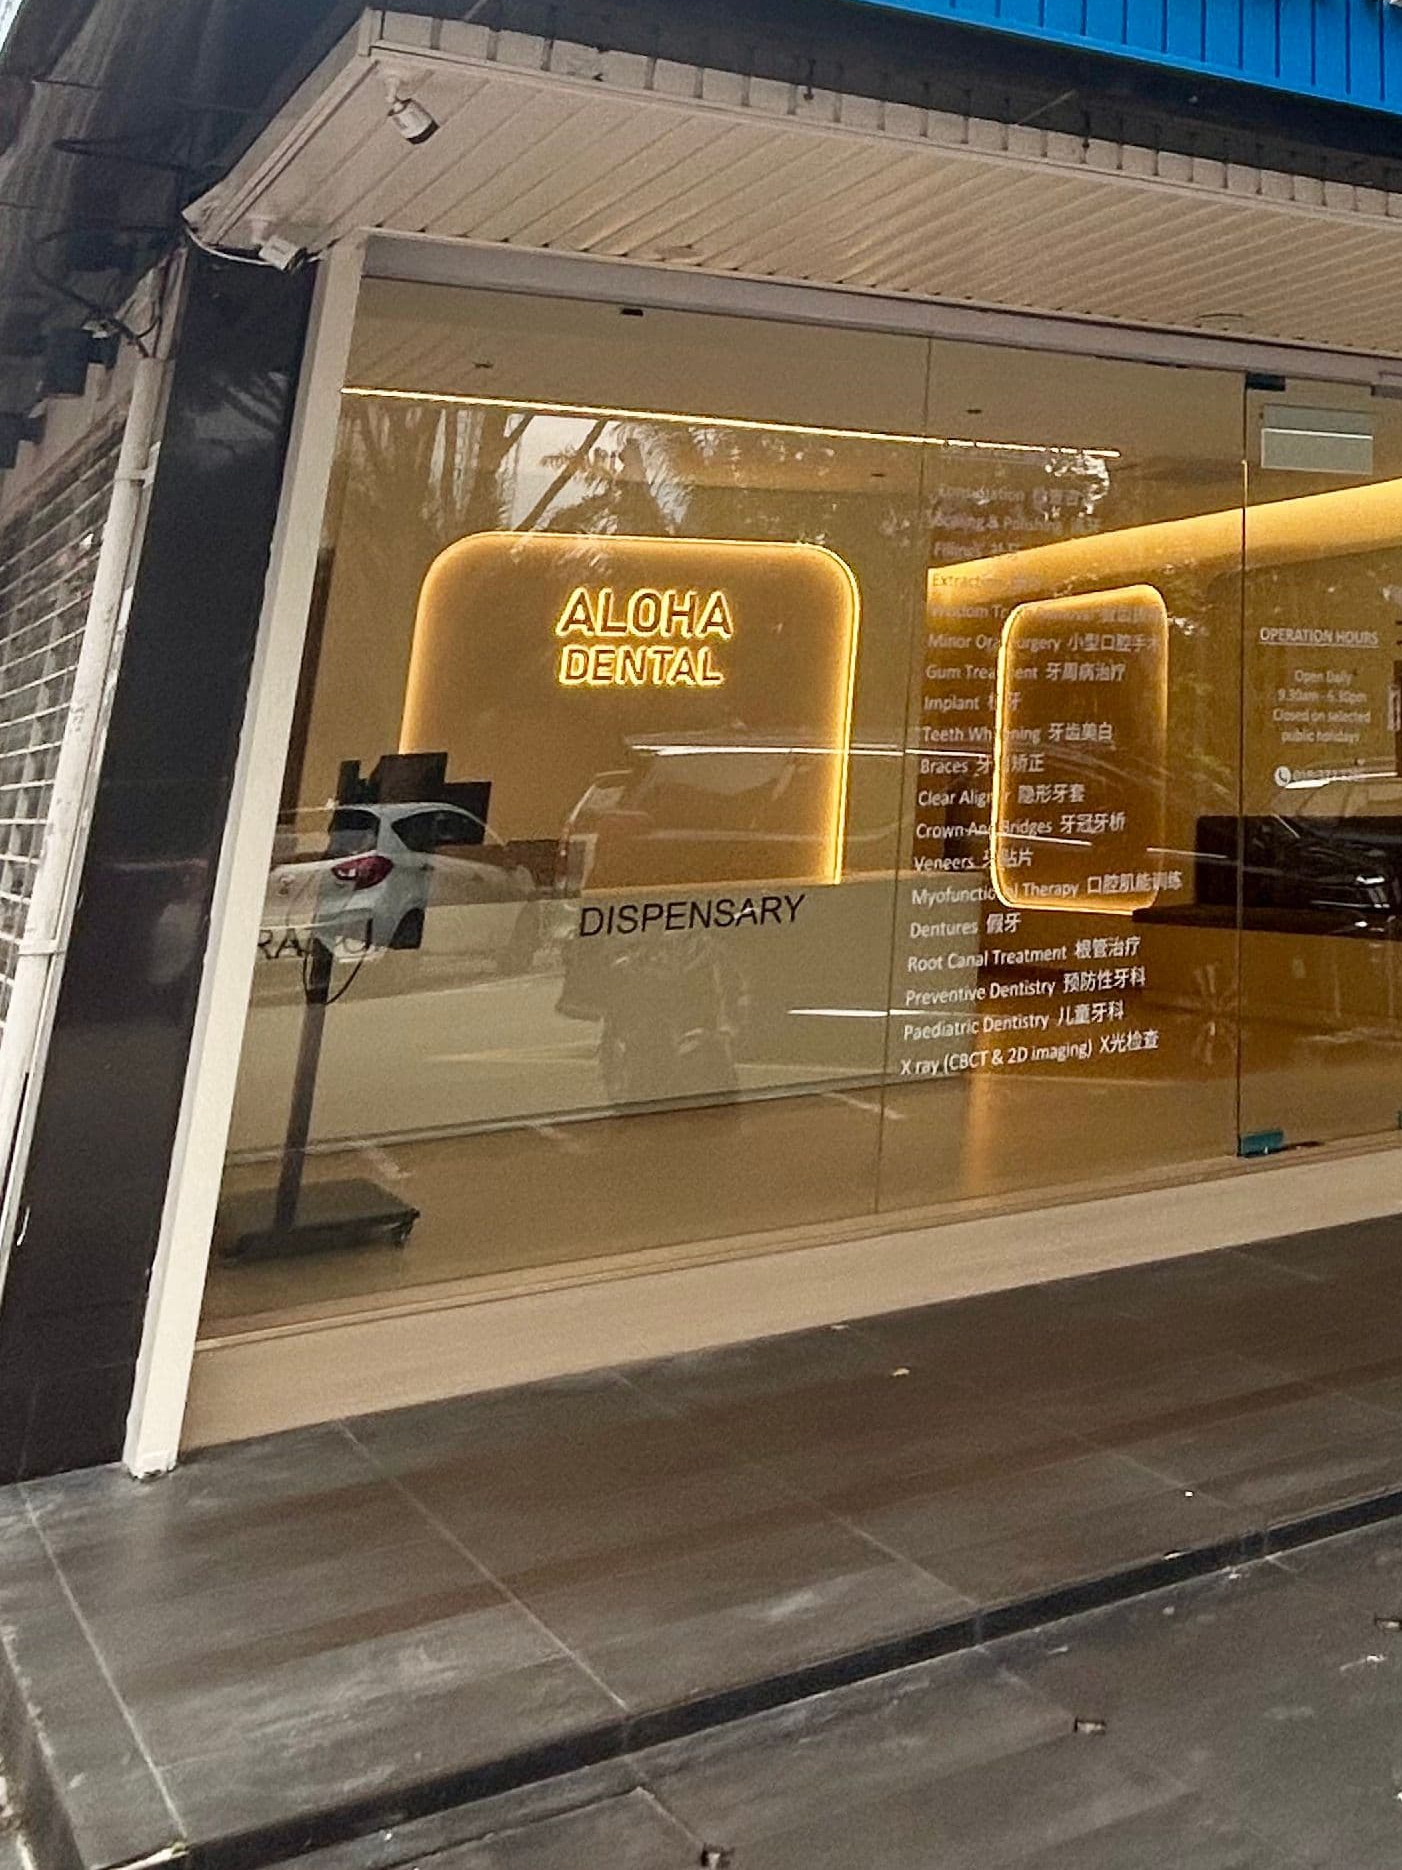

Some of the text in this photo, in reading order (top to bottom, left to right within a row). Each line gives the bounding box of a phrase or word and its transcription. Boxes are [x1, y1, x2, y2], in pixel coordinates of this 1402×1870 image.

[555, 587, 734, 640] ALOHA
[927, 633, 971, 649] Minor
[1012, 636, 1062, 655] urgery
[1260, 627, 1378, 645] OPERATION HOURS
[557, 643, 727, 686] DENTAL
[926, 662, 1127, 682] Gum Treaent 牙周病治疗
[1295, 670, 1353, 686] Open Daily
[923, 694, 980, 713] Implant
[1272, 708, 1371, 723] Closed on selected
[922, 725, 965, 742] Teeth
[1047, 722, 1114, 743] 牙齿美白
[1281, 730, 1315, 744] public
[920, 753, 1045, 776] Braces 牙矫正
[918, 789, 956, 807] Clear
[1018, 783, 1086, 805] 隐形牙套
[916, 821, 964, 840] Crown
[914, 855, 975, 872] Veneers
[1022, 881, 1079, 903] Therapy
[1087, 871, 1183, 894] 口腔肌能训练
[580, 894, 806, 937] DISPENSARY
[909, 912, 1021, 939] Dentures 假牙
[908, 935, 1141, 972] Root Canal Treatment 根管治疗
[905, 966, 1146, 1007] Preventive Dentistry 预防性牙科
[904, 999, 1124, 1041] Paediatric Dentistry 儿童牙科
[900, 1029, 1159, 1076] X ray (CBCT & 2D imaging) X光检查
